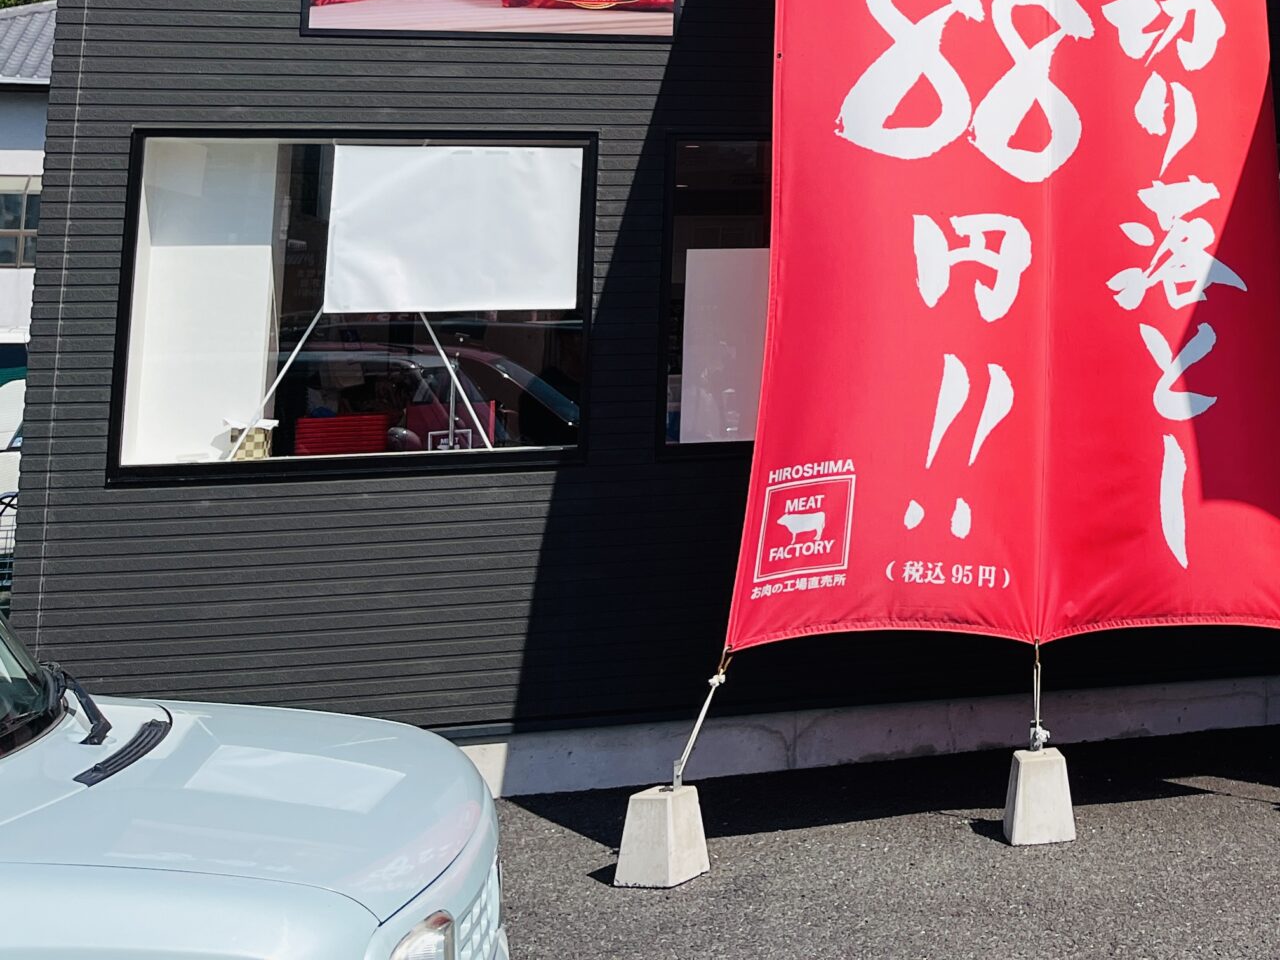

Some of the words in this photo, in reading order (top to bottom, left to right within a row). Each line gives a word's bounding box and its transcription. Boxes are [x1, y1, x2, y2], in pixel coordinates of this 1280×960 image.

[768, 458, 856, 484] HIROSHIMA
[784, 494, 825, 514] MEAT
[768, 539, 836, 562] FACTORY
[750, 573, 848, 600] お肉の工場直売所
